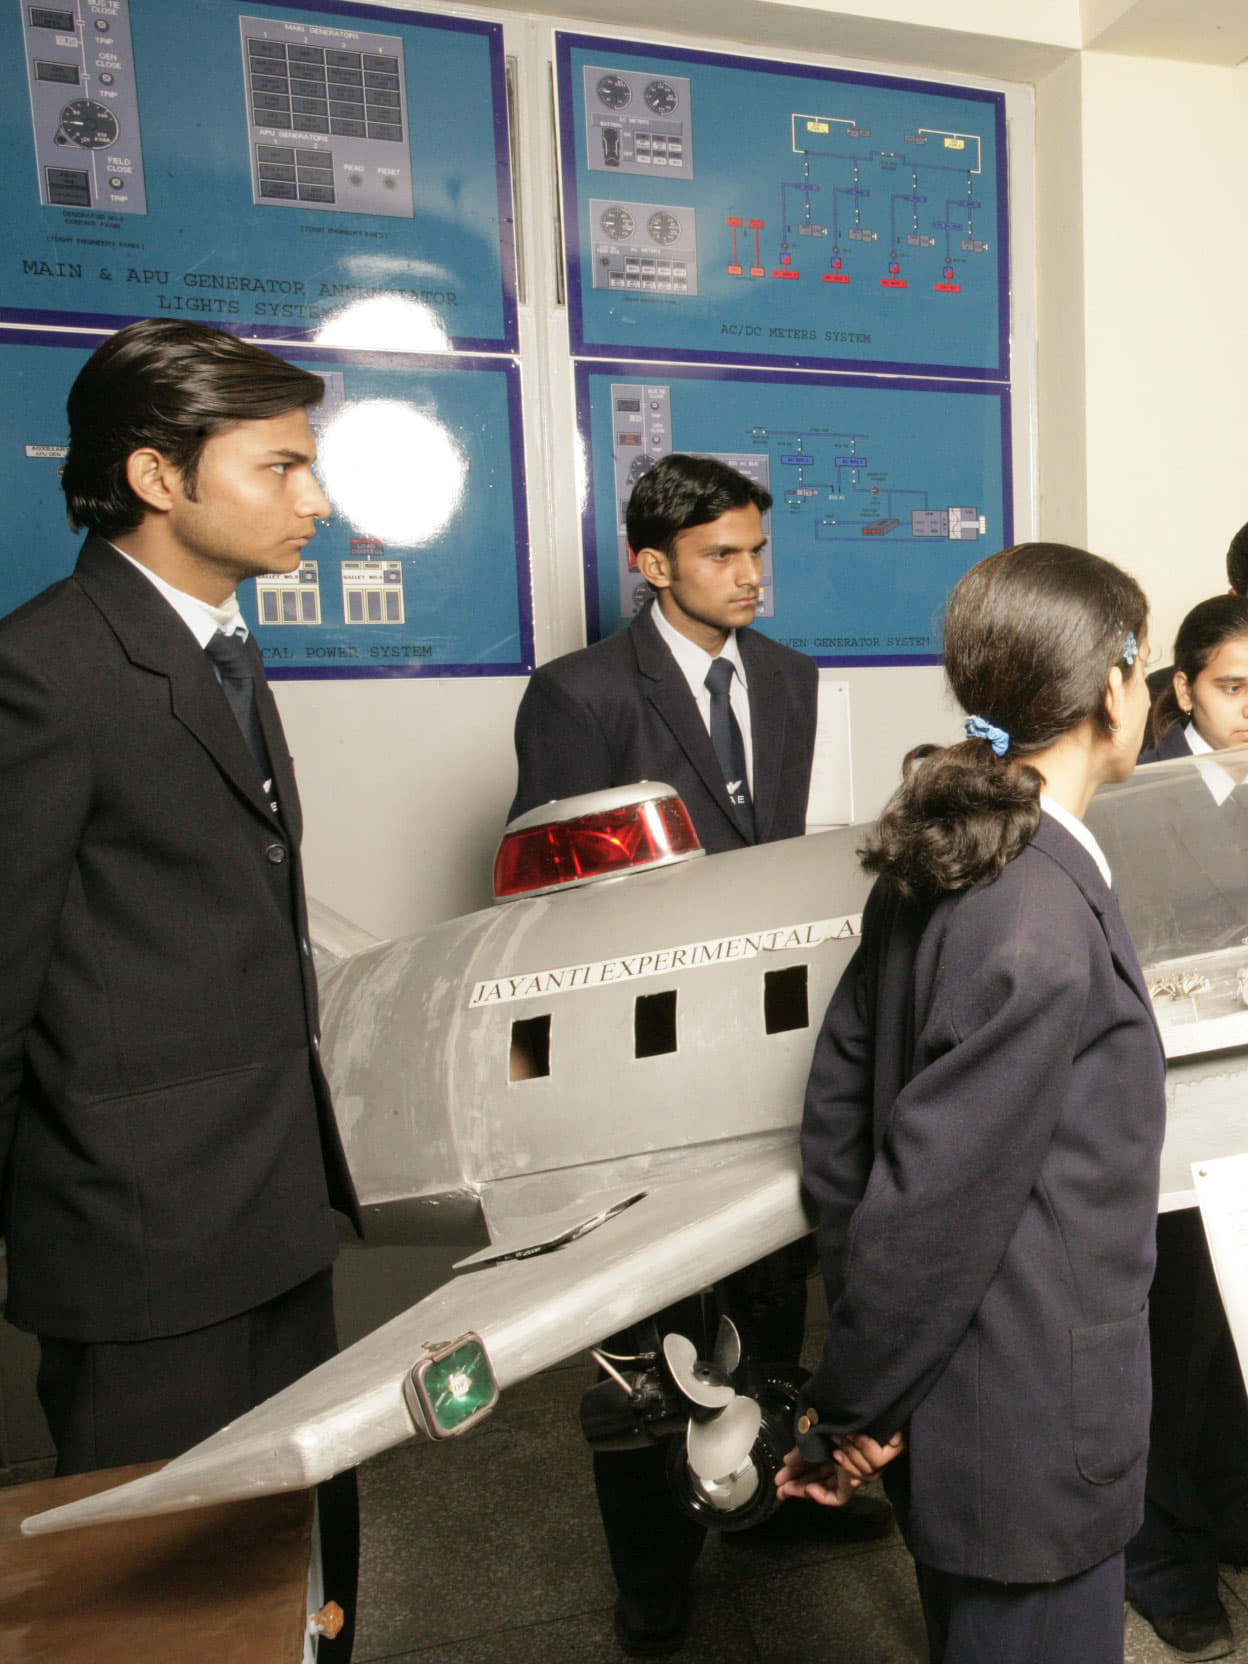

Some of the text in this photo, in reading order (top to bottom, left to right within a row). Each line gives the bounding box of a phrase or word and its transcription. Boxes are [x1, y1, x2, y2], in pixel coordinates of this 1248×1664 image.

[22, 259, 82, 278] MAIN
[100, 267, 113, 281] &
[127, 268, 170, 284] APU
[183, 272, 306, 296] GENERATOR
[158, 295, 240, 314] LIGHTS
[721, 324, 871, 344] AC/DC METERS SYSTEM
[813, 637, 881, 648] GENERATOR
[887, 636, 930, 647] SYSTEM
[306, 647, 359, 659] POWER
[370, 646, 433, 657] SYSTEM
[472, 966, 591, 1004] JAYANTI
[600, 925, 822, 982] EXPERIMENTAL
